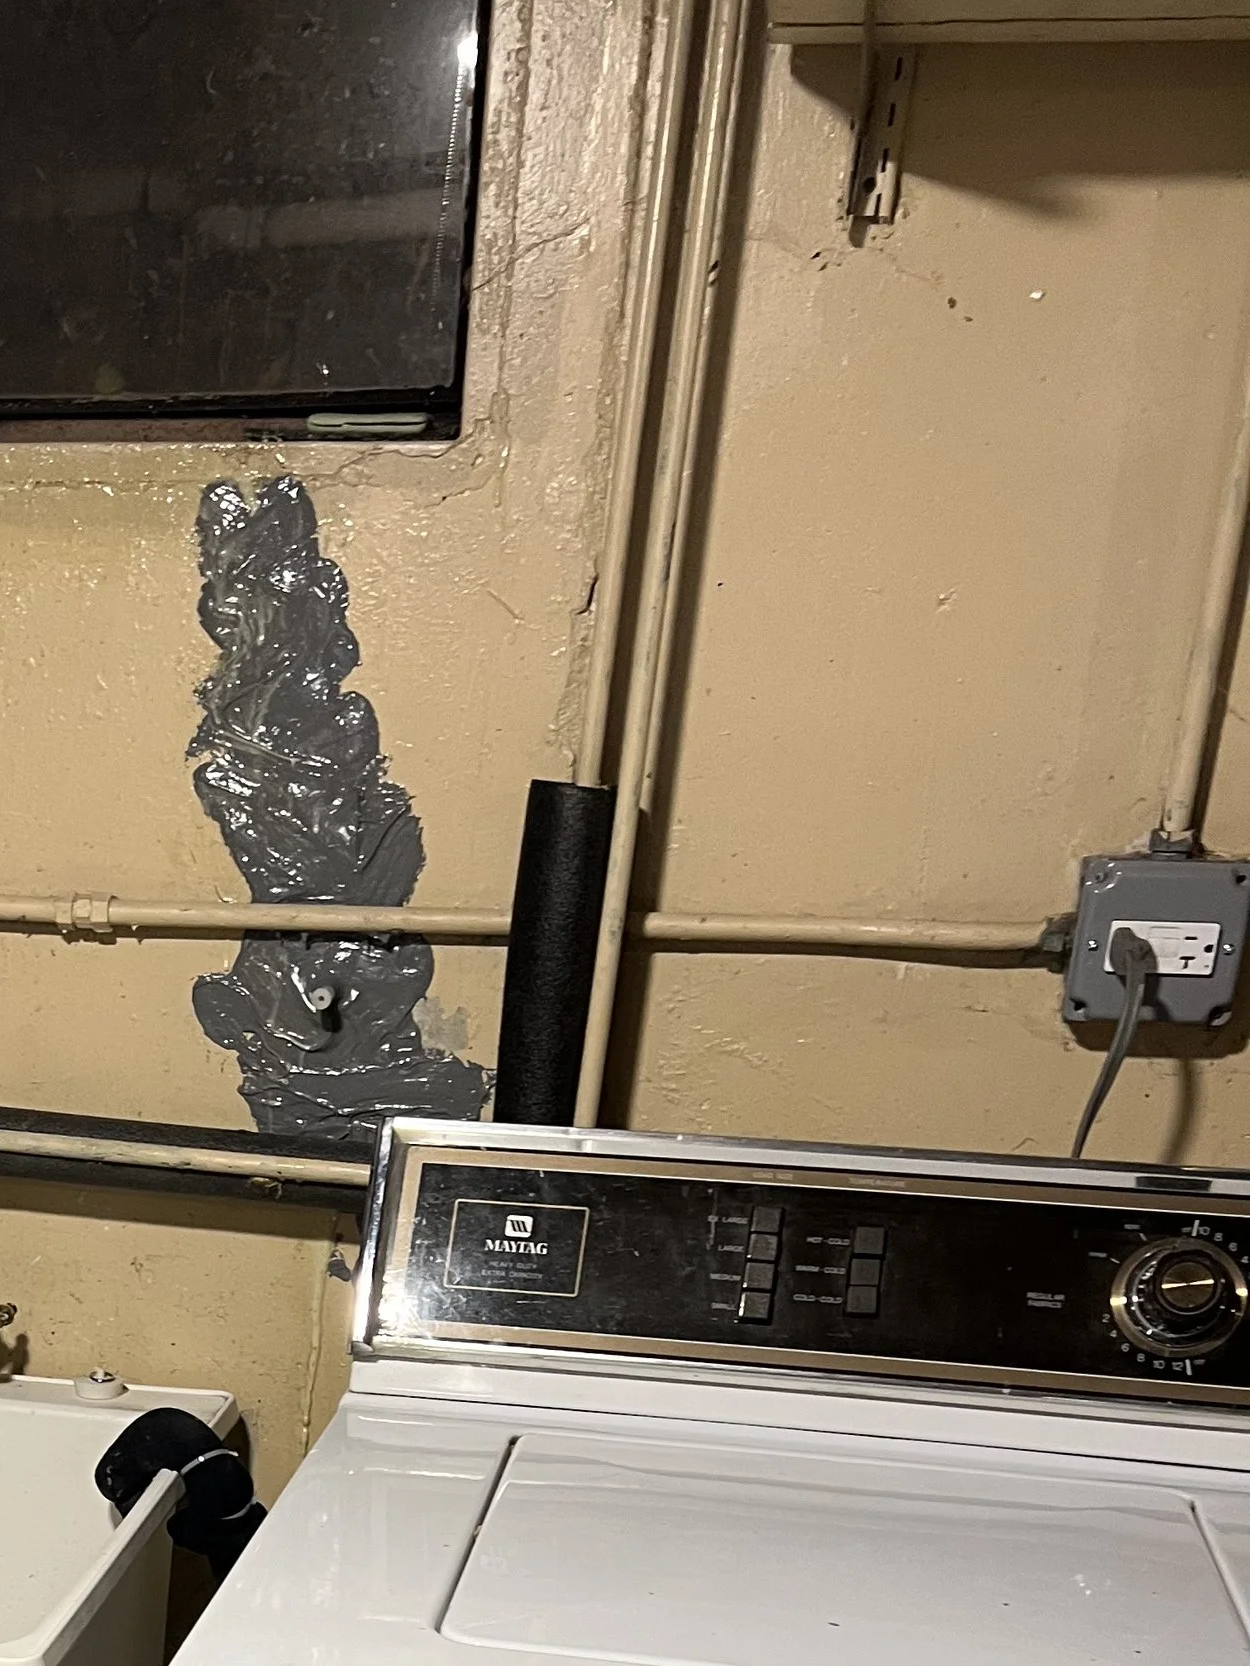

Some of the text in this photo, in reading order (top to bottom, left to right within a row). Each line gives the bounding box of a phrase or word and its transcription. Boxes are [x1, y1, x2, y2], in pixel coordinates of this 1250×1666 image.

[484, 1239, 549, 1255] MAYTAG
[1101, 1314, 1110, 1324] 2
[1109, 1330, 1118, 1338] 4
[1121, 1343, 1130, 1352] 6
[1136, 1353, 1146, 1363] 8
[1152, 1360, 1166, 1370] 10
[1171, 1361, 1184, 1371] 12
